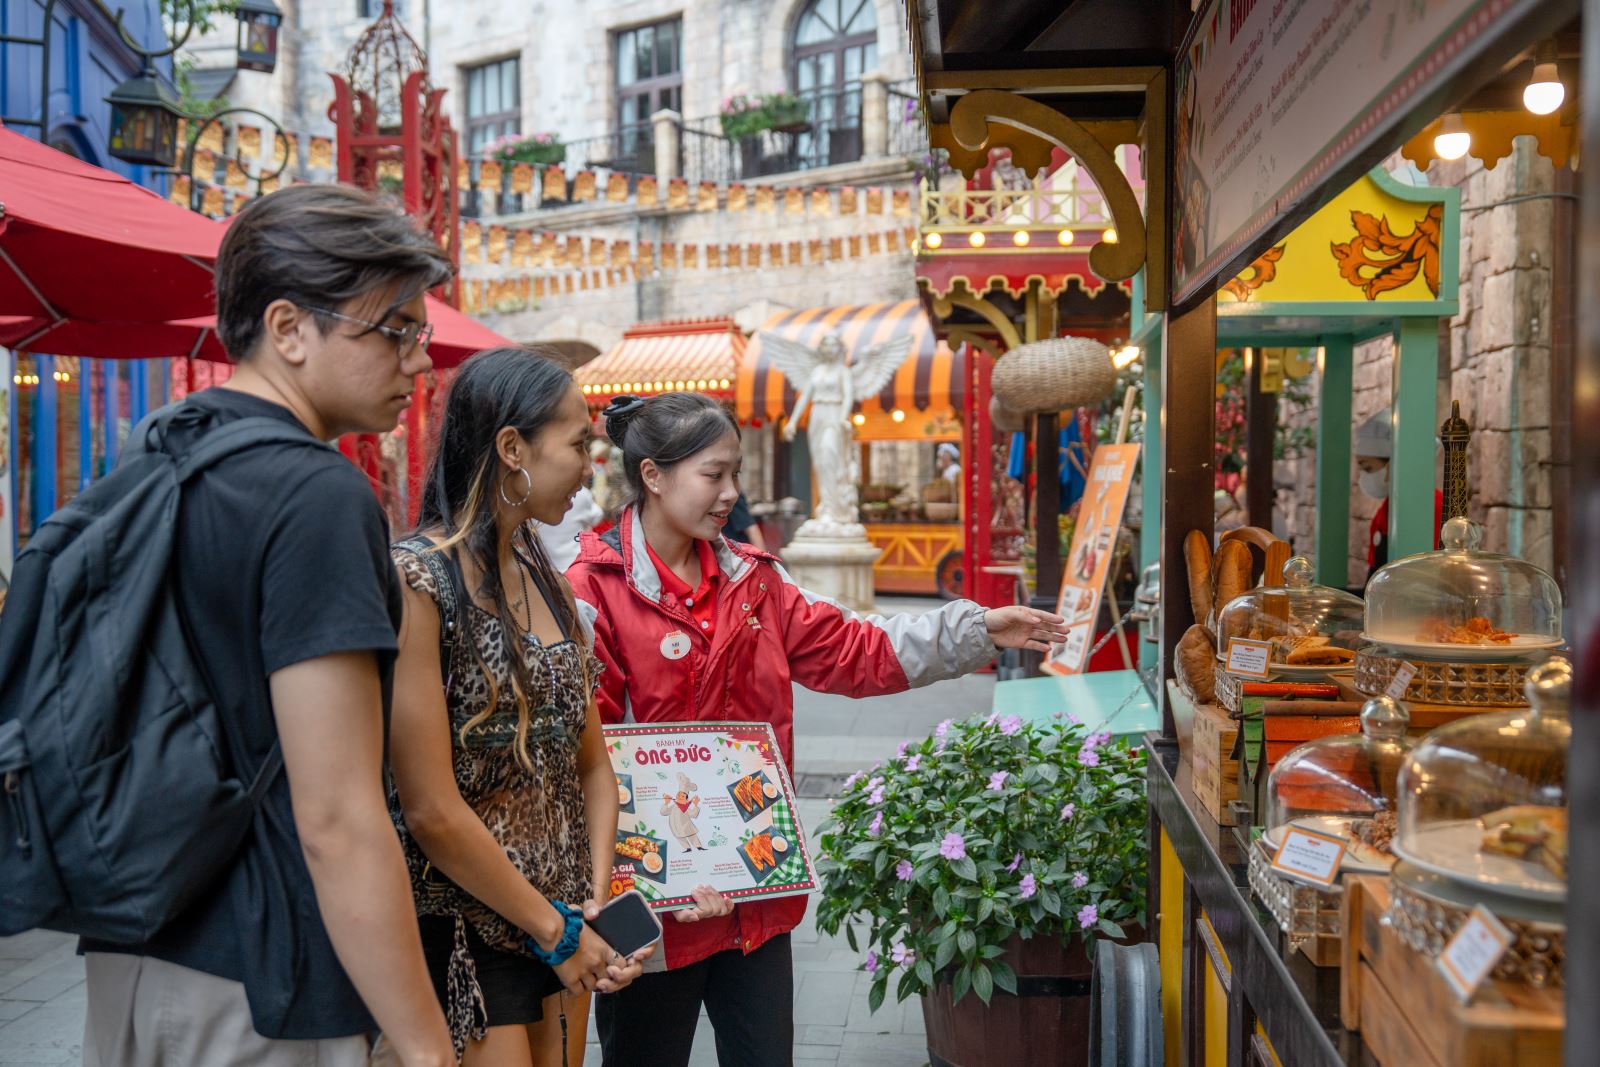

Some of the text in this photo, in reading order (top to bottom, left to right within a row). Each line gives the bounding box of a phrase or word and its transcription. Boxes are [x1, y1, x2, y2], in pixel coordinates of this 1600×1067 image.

[635, 744, 711, 765] ÔNG ĐỨC
[618, 863, 636, 873] GIÁ
